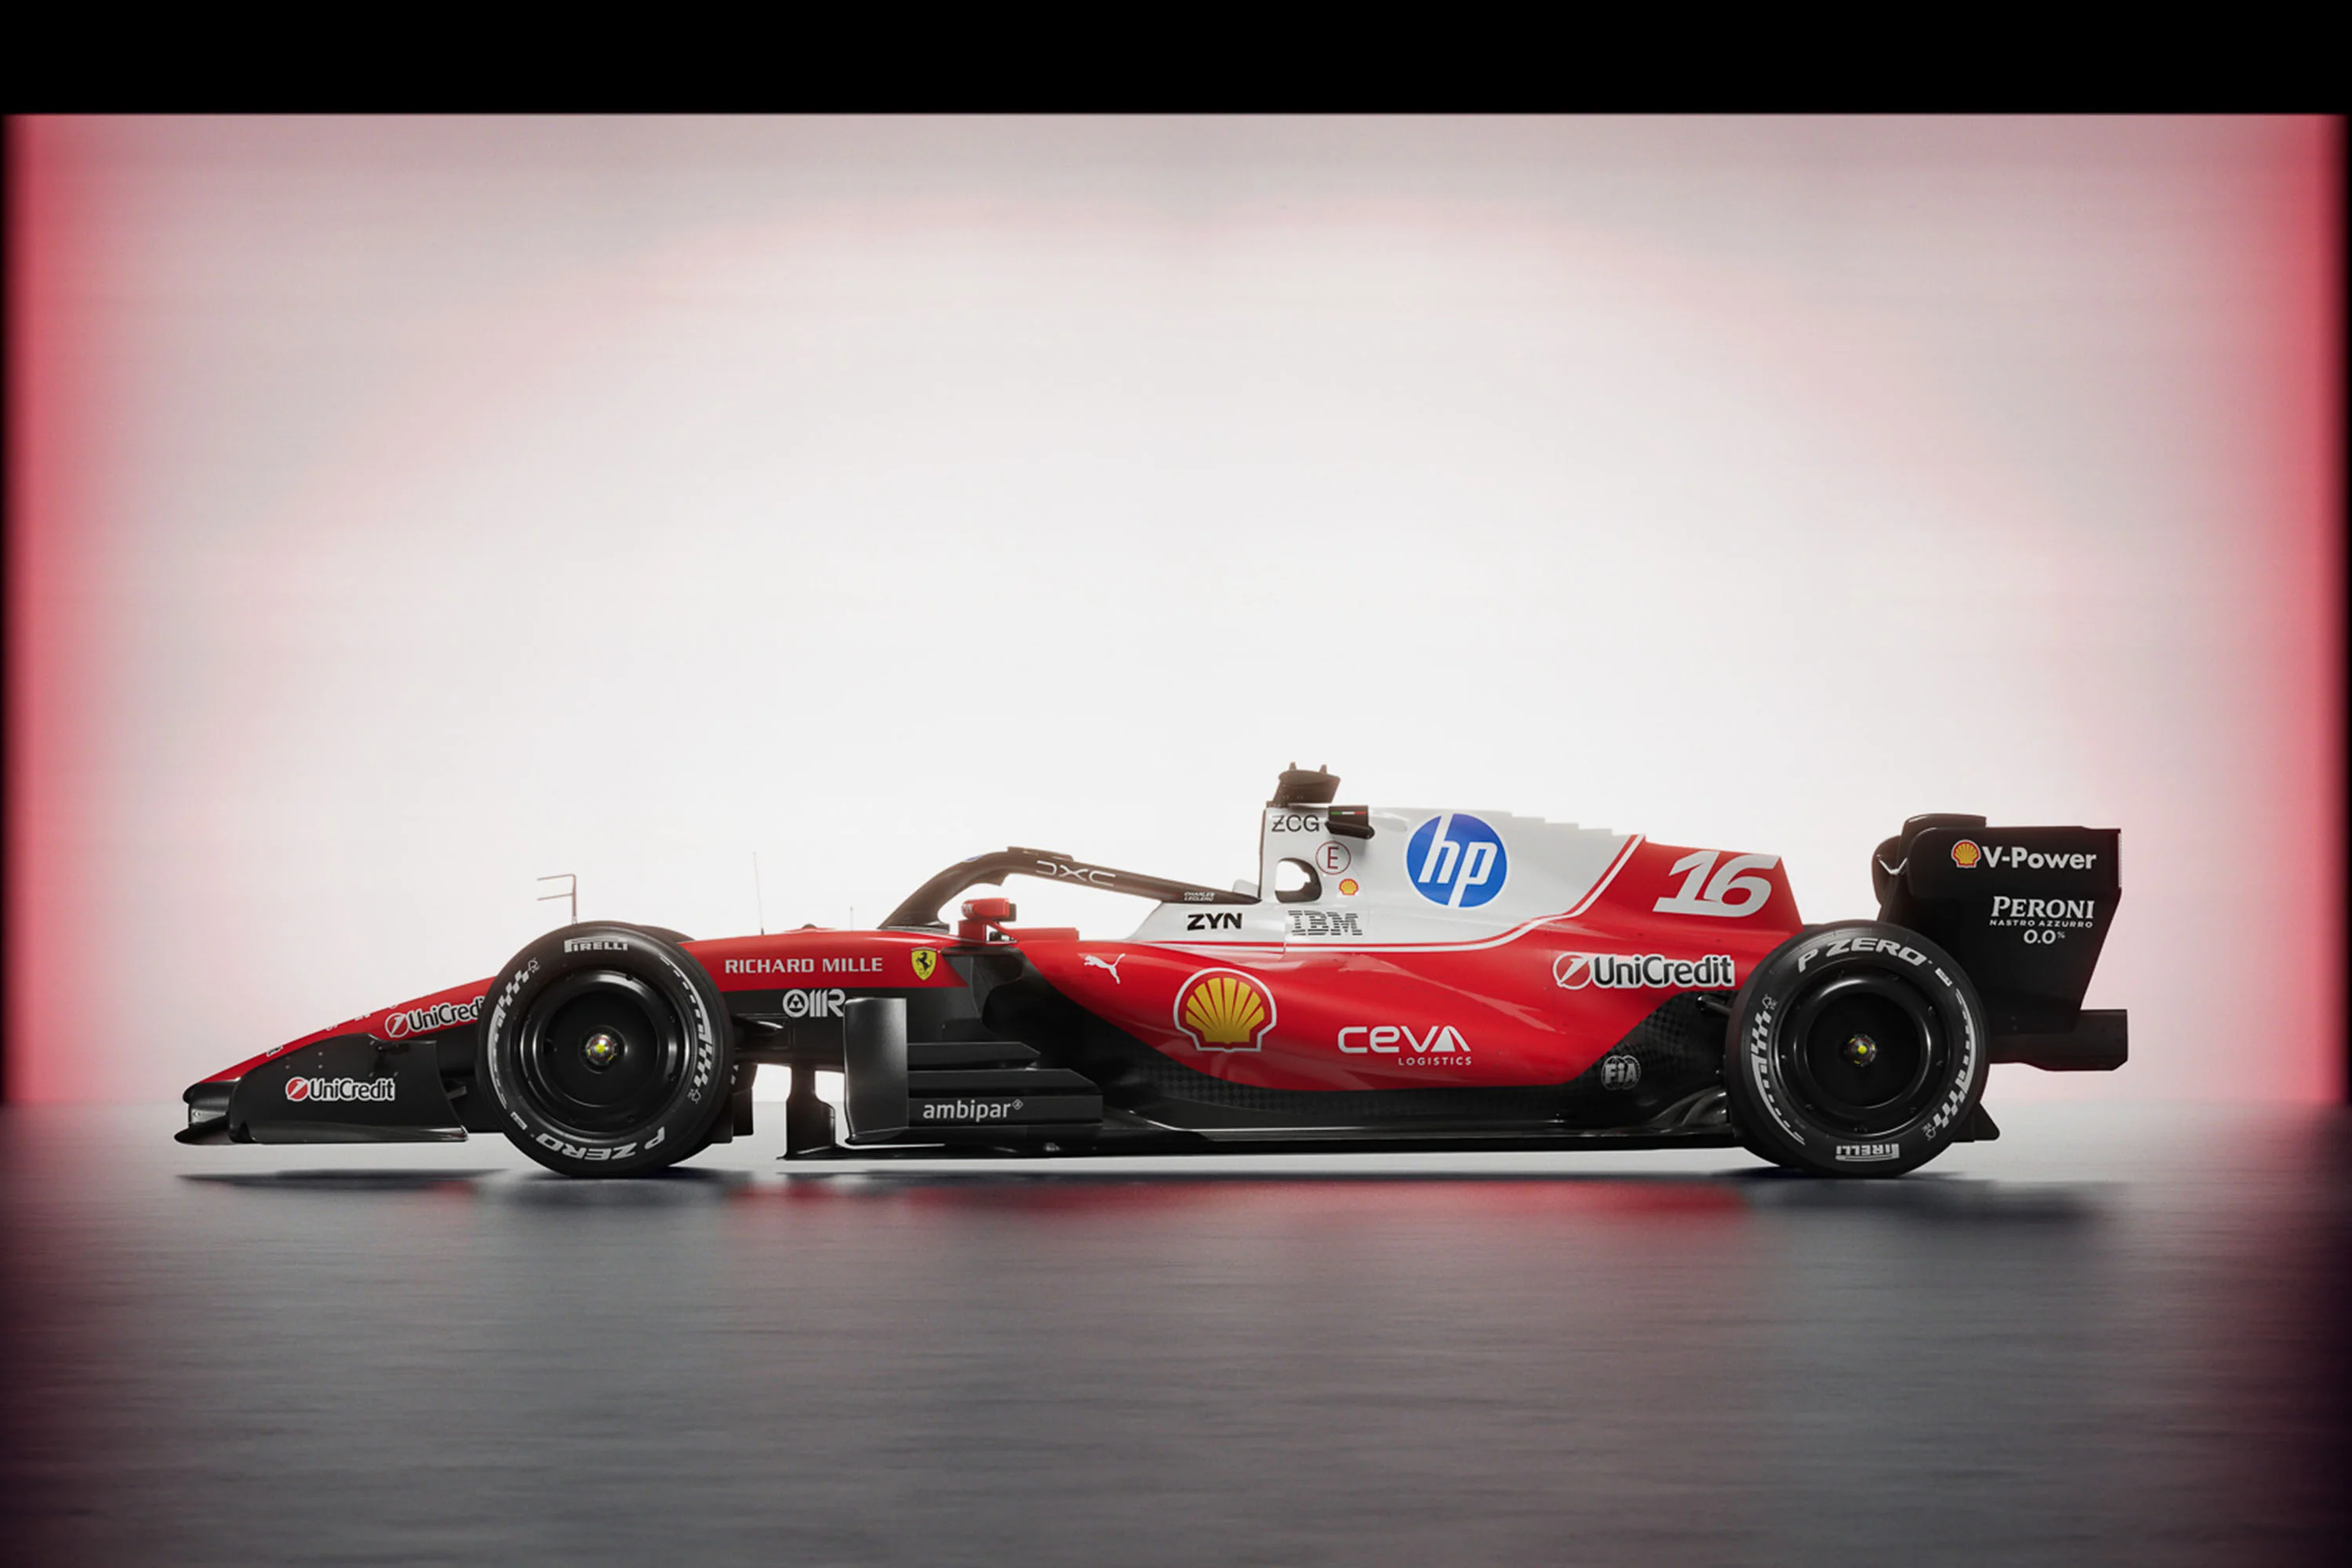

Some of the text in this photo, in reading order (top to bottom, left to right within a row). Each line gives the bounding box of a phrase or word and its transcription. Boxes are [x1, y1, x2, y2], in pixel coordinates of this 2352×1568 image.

[1272, 815, 1320, 833] ZCG
[1327, 847, 1339, 869] E
[1417, 813, 1498, 908] hp
[1982, 846, 2097, 869] V-Power
[1036, 860, 1116, 887] DXC
[1653, 851, 1781, 918] 16
[1991, 896, 2096, 919] PERONI
[1187, 913, 1243, 931] ZYN
[1288, 910, 1363, 936] IBM
[564, 938, 628, 953] PIRELLI
[1798, 938, 1928, 973] P ZERO
[725, 957, 883, 974] RICHARD MILLE
[1594, 956, 1732, 985] UniCredit
[1398, 1056, 1472, 1066] LOGISTICS
[310, 1079, 394, 1100] UniCredit
[923, 1099, 1011, 1122] ambipar
[535, 1127, 665, 1160] P ZERO
[1835, 1143, 1900, 1162] PIRELLI
